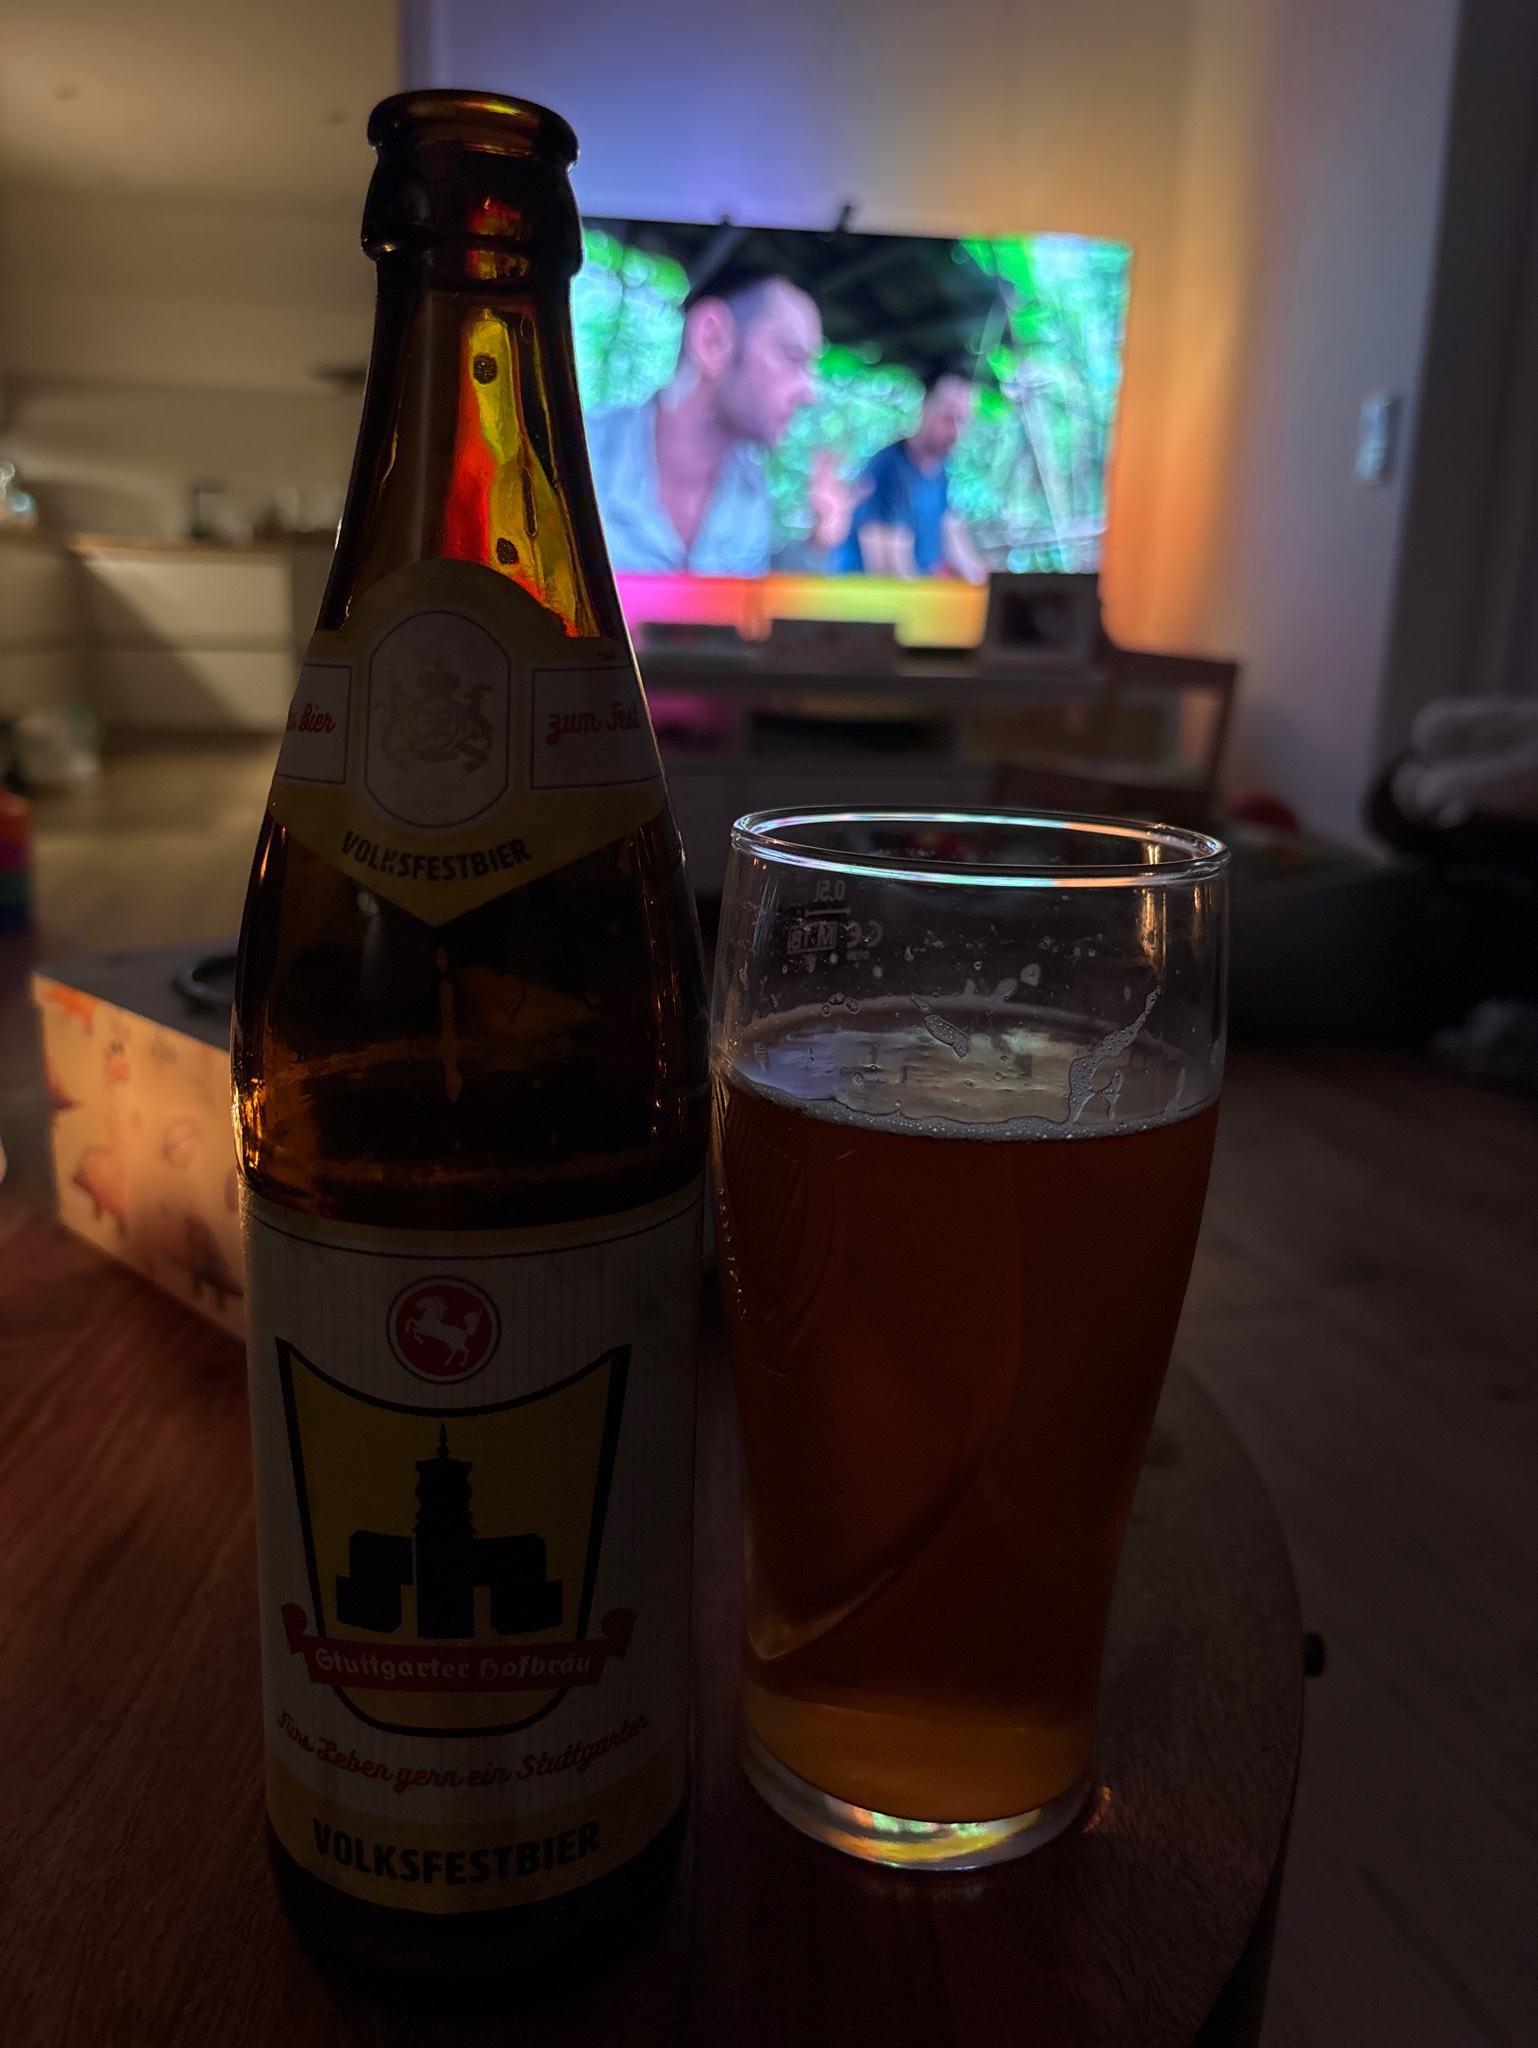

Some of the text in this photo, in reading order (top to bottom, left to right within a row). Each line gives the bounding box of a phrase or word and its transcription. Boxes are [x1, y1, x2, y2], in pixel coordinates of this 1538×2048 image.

[298, 702, 336, 734] Bier
[545, 701, 641, 746] zum Fest
[341, 829, 532, 881] VOLKSFESTBIER
[315, 1649, 592, 1682] Stuttgarter Hofbräu
[317, 1737, 394, 1782] Leben
[392, 1767, 464, 1792] gern
[467, 1761, 512, 1787] ein
[516, 1714, 650, 1780] Stuttgarter
[313, 1816, 600, 1884] VOLKSFESTBIER
